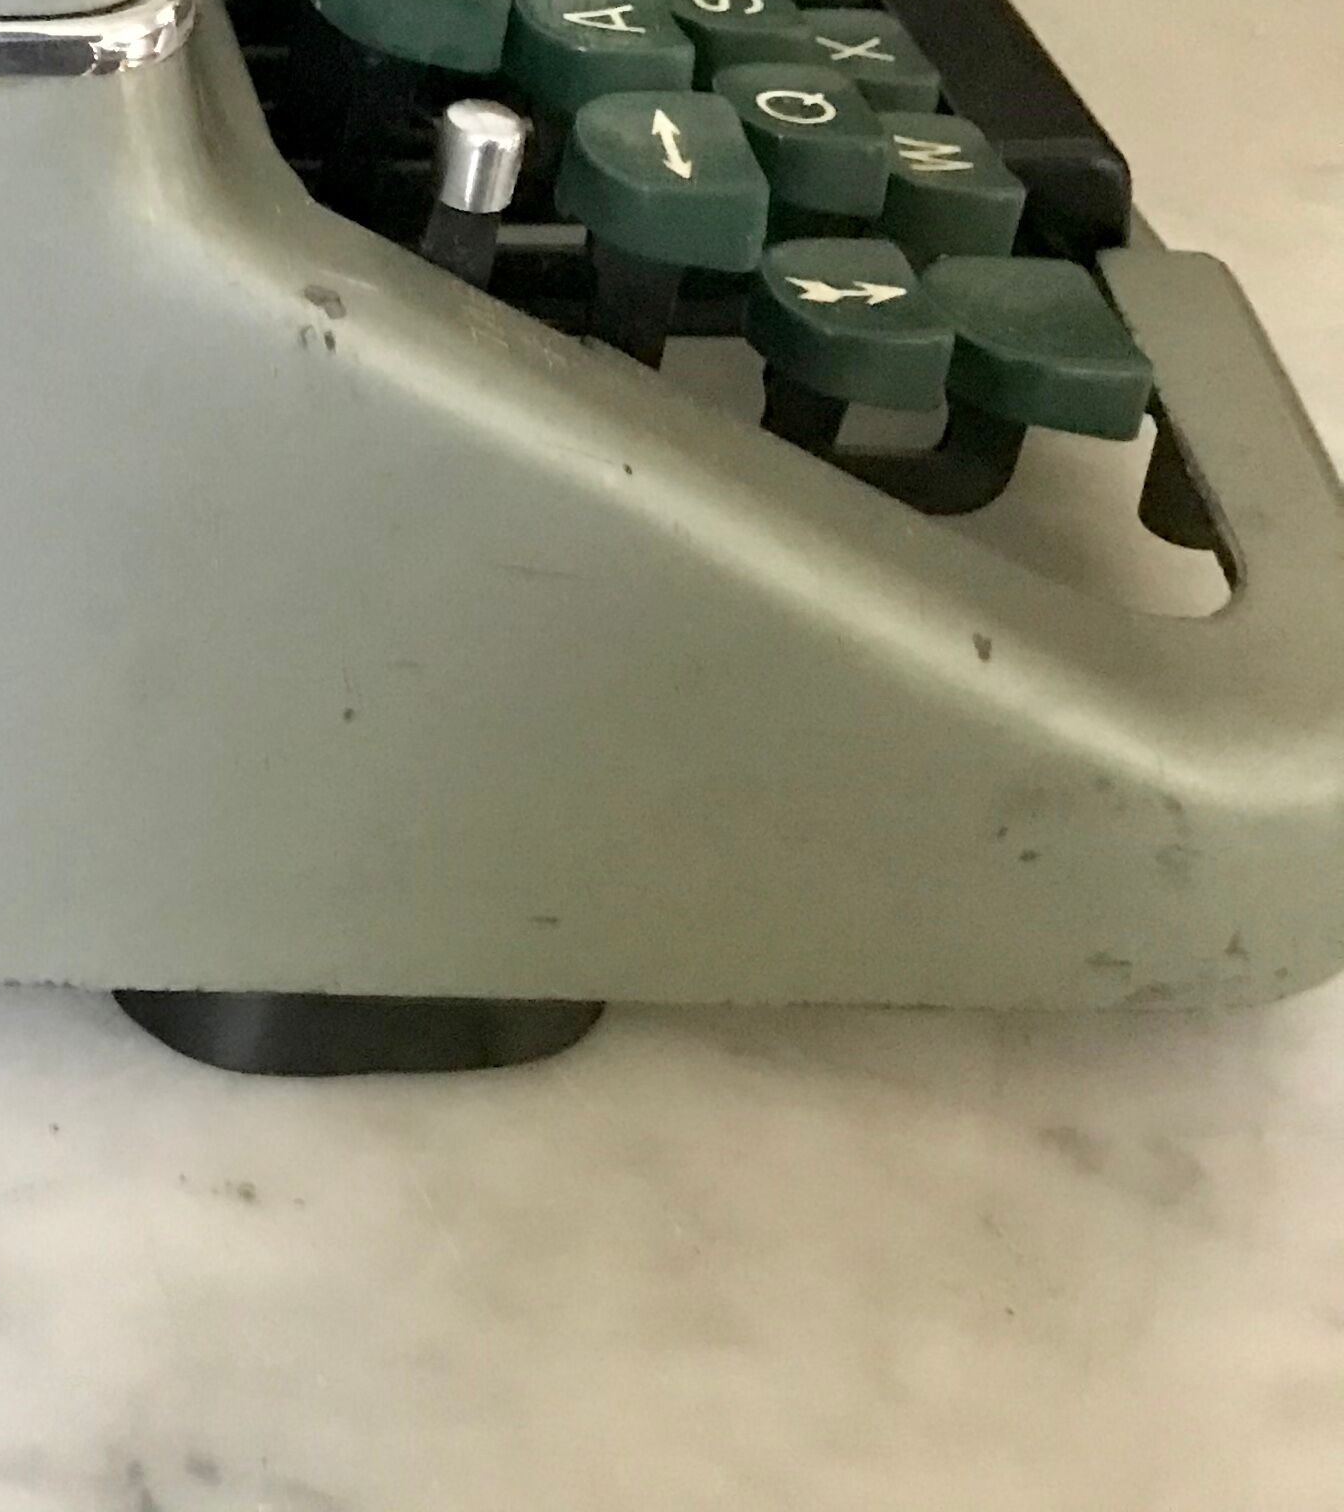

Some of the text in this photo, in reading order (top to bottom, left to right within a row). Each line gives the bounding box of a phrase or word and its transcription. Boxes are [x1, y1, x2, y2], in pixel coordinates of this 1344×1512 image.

[563, 5, 645, 32] A
[817, 37, 894, 61] X
[756, 91, 835, 123] Q
[894, 135, 973, 170] W
